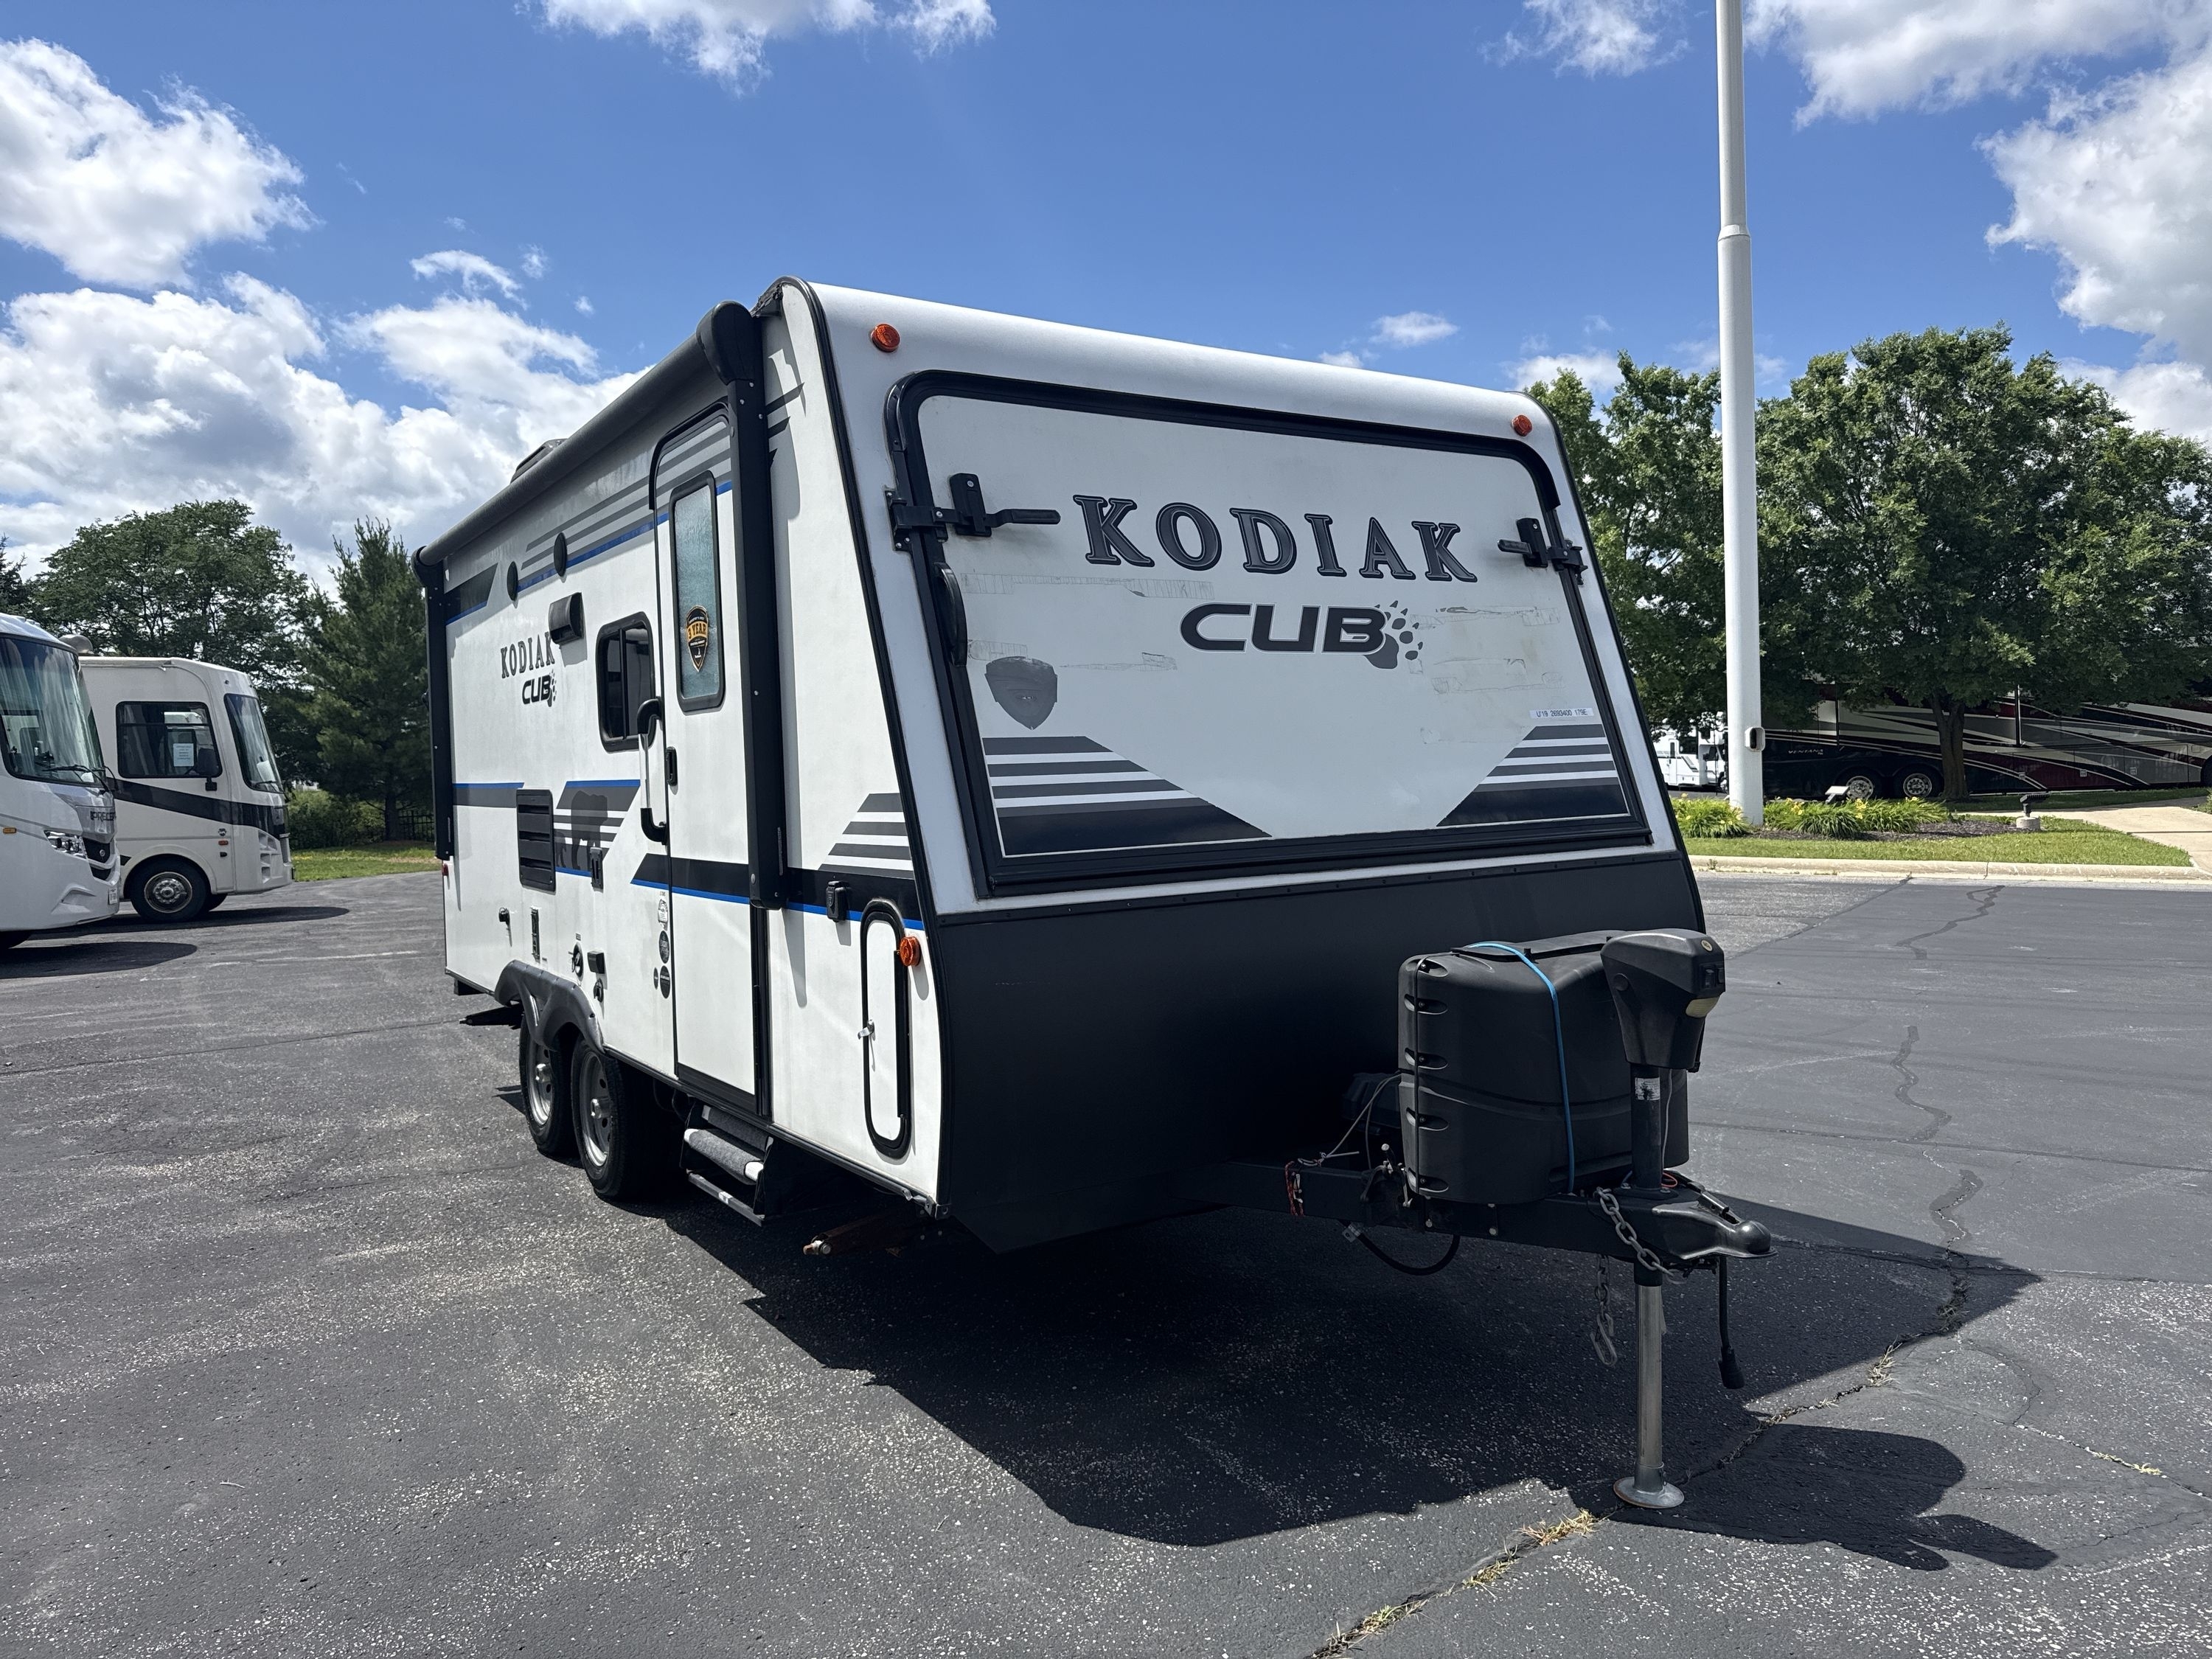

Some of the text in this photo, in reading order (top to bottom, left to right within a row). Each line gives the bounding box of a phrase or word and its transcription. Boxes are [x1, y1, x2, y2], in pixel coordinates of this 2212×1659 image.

[1073, 495, 1478, 582] KODIAK
[692, 622, 706, 636] YEAR
[1180, 602, 1387, 653] CUB
[501, 631, 555, 678] KODIAK
[522, 675, 552, 704] CUB
[91, 811, 116, 821] PRECE
